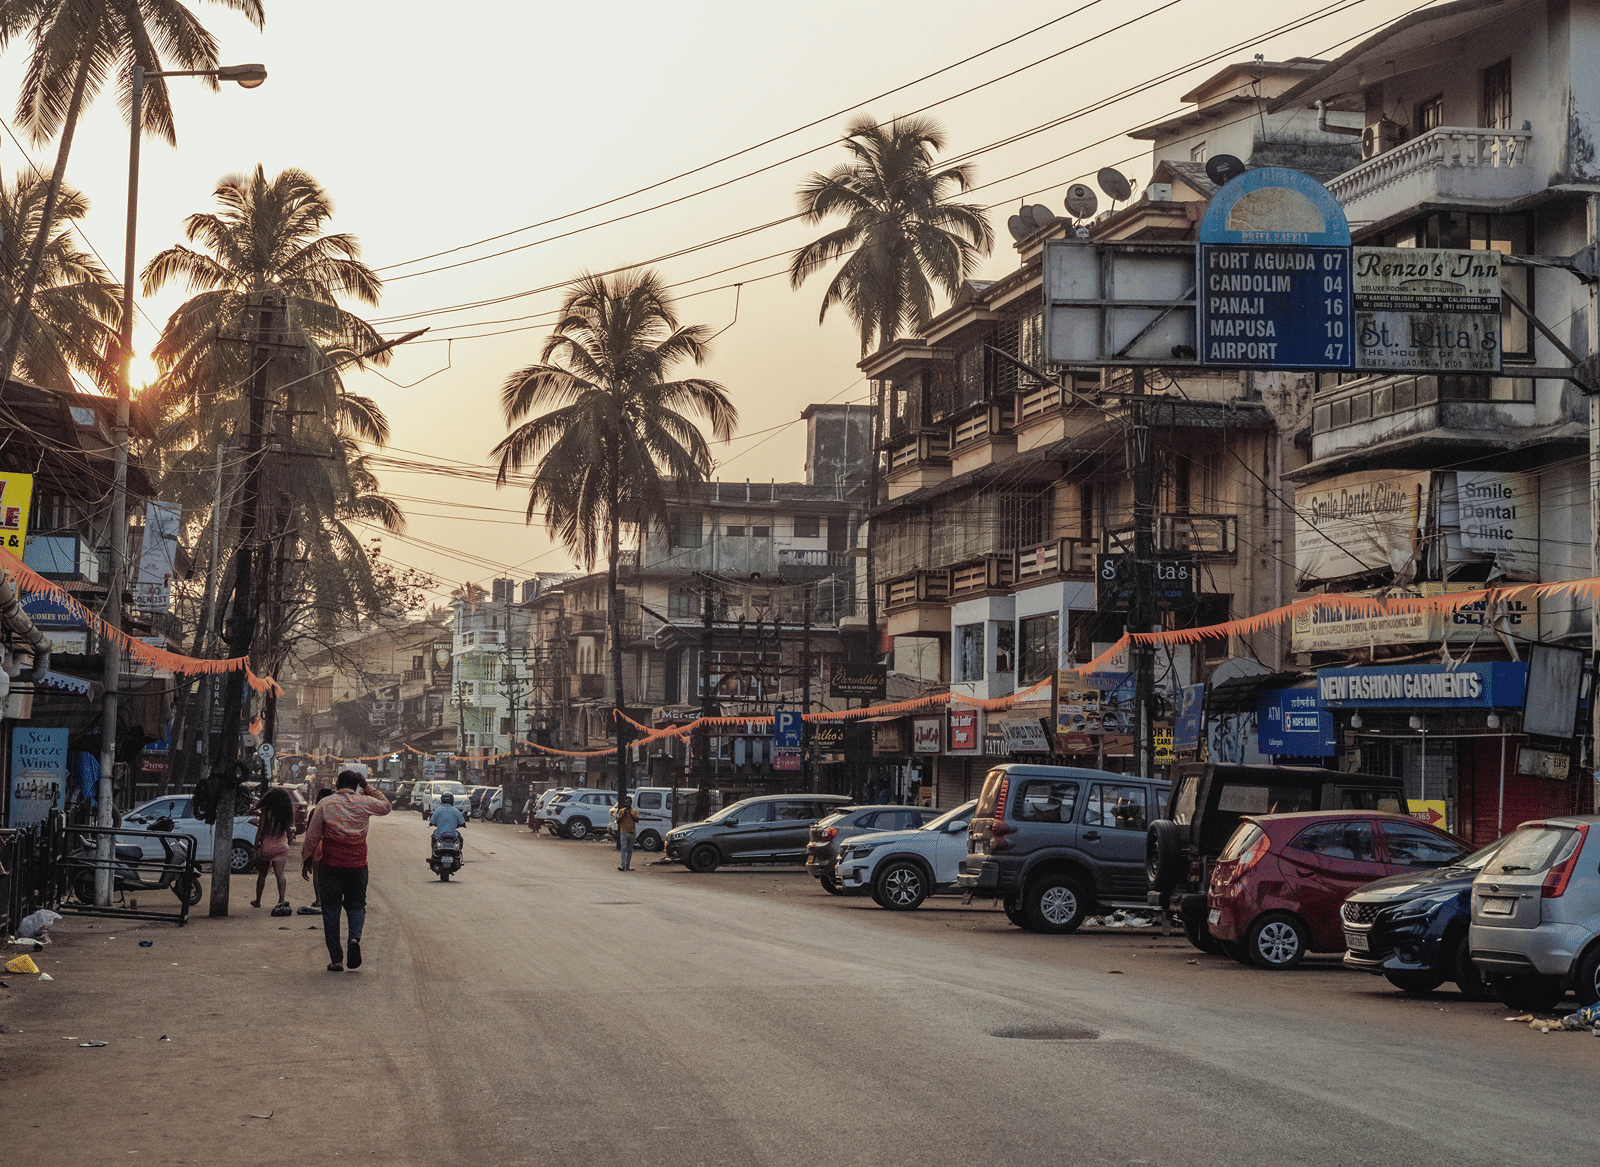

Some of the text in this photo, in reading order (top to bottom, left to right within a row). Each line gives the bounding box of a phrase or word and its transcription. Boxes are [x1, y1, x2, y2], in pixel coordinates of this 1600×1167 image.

[1242, 233, 1309, 242] DRIVE SAFELY
[1210, 252, 1342, 270] FORT AGUADA 07
[1356, 253, 1498, 278] Renzo's Inn
[1210, 275, 1342, 292] CANDOLIM 04
[1210, 297, 1343, 315] PANAJI 16
[1210, 320, 1343, 337] MAPUSA 10
[1360, 320, 1497, 350] St. Rita's
[1210, 342, 1343, 360] AIRPORT 47
[1464, 483, 1512, 499] Smile
[1311, 482, 1407, 526] Smile Dental Clinic
[1462, 504, 1516, 519] Dental
[1466, 524, 1514, 540] Clinic
[57, 613, 70, 621] YOU
[832, 671, 884, 686] Carvalho's
[1320, 672, 1479, 700] NEW FASHION GARMENTS
[1268, 706, 1280, 720] ATM
[780, 714, 793, 732] P
[1292, 718, 1317, 727] HDFC BANK
[29, 731, 51, 744] Sea
[17, 745, 62, 756] Breeze
[985, 739, 1010, 755] TATTOO
[18, 757, 60, 769] Wines
